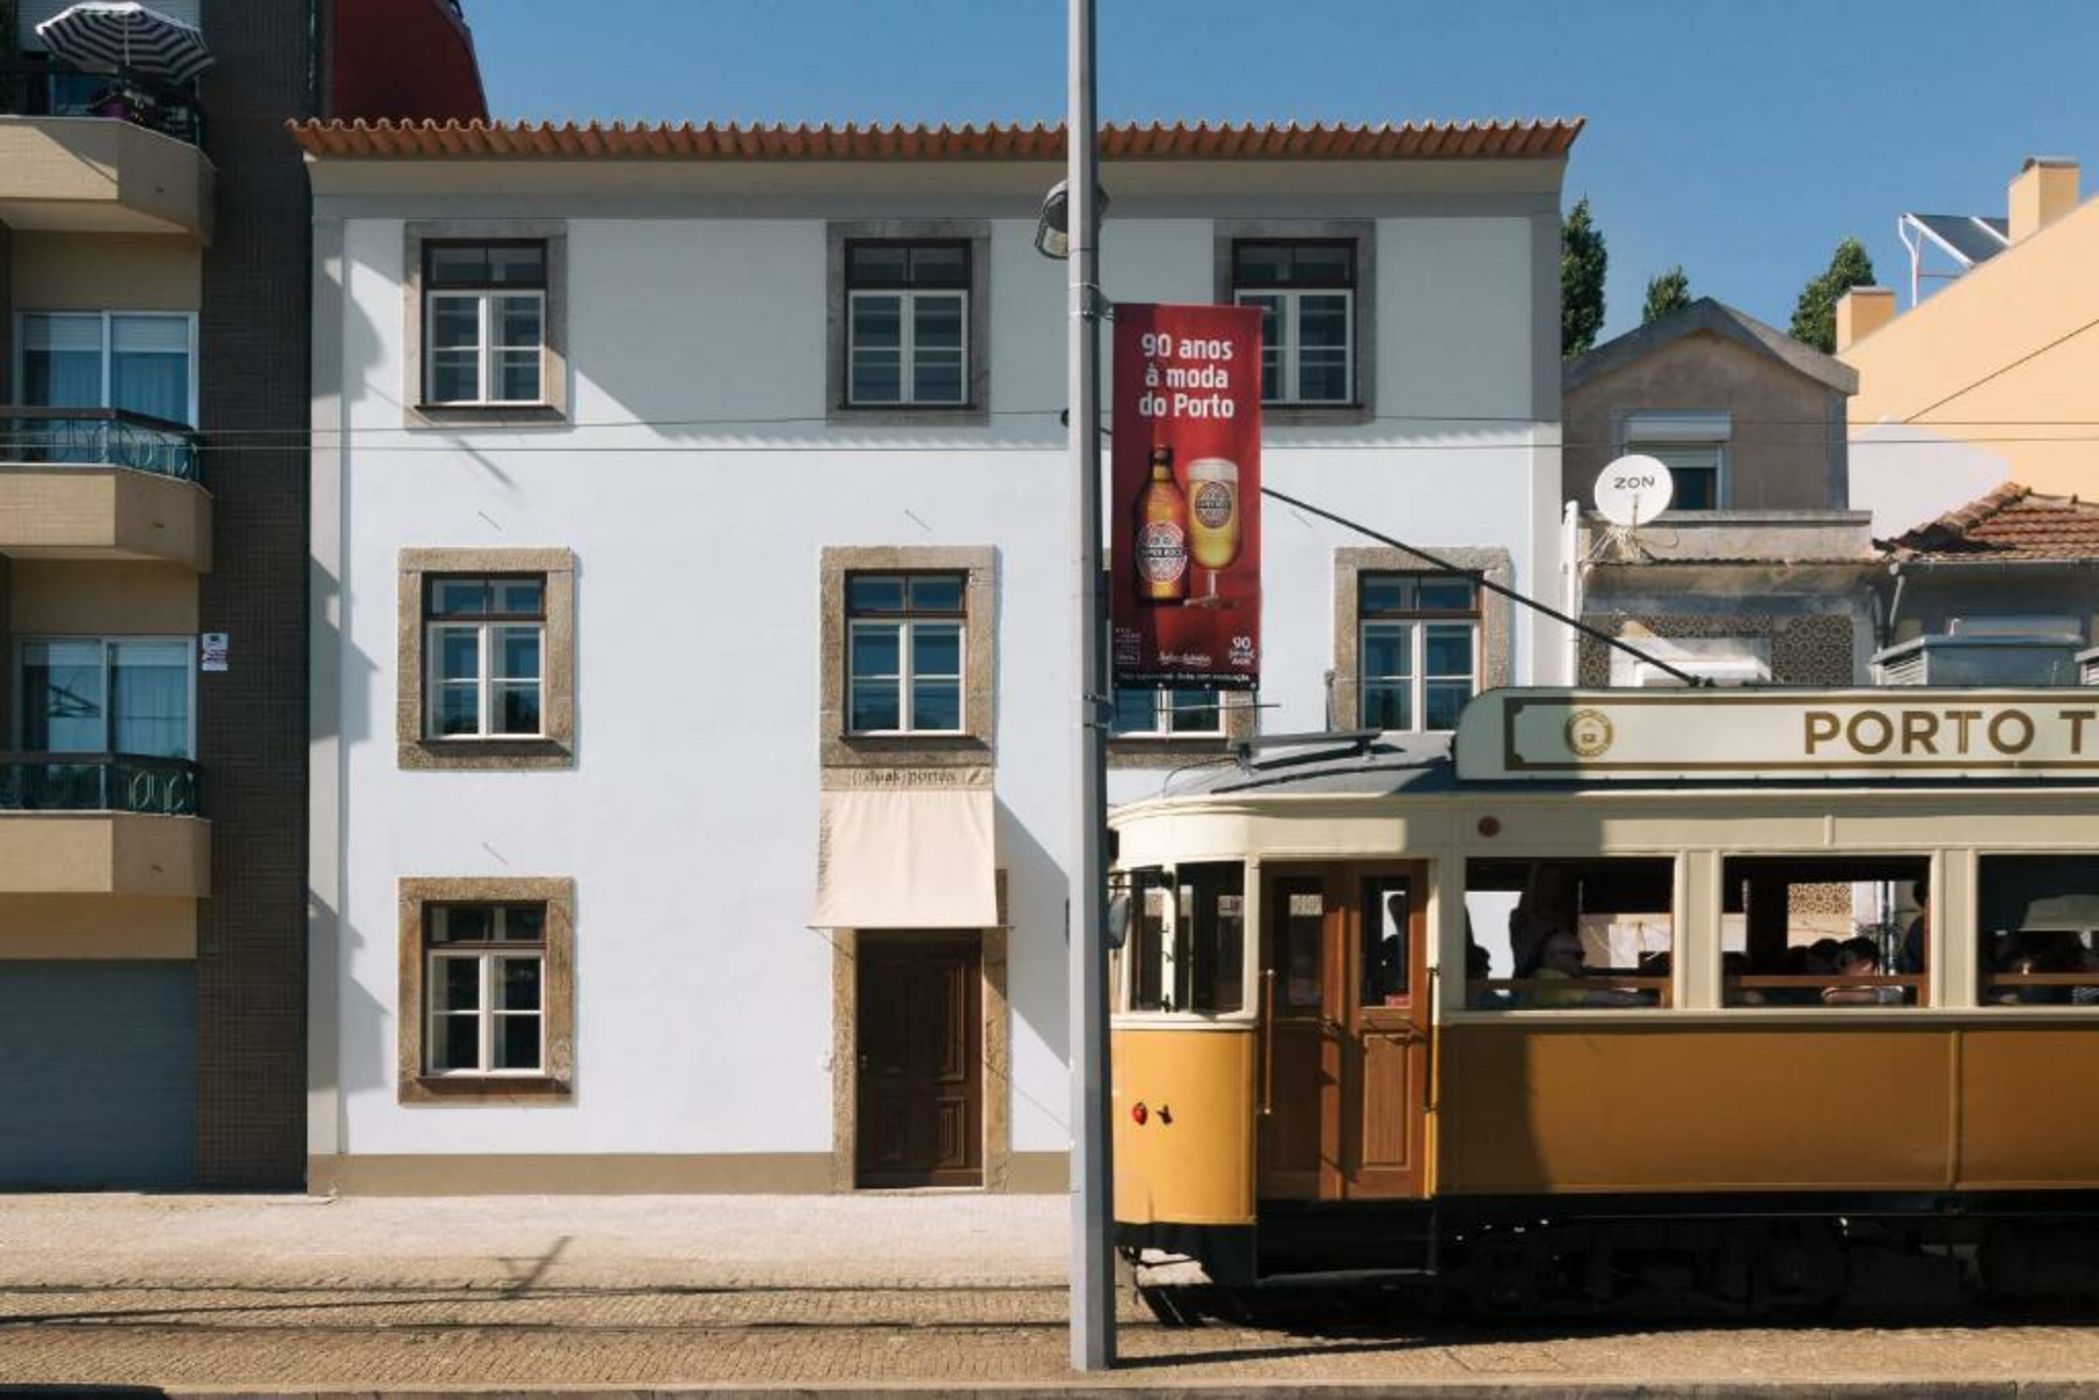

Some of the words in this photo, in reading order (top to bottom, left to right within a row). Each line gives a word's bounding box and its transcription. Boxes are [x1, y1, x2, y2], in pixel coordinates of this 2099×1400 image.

[1142, 333, 1172, 357] 90
[1179, 338, 1233, 360] anos
[1166, 363, 1228, 389] moda
[1140, 391, 1167, 417] do
[1174, 393, 1234, 418] Porto
[1614, 476, 1656, 490] ZON
[1231, 636, 1252, 650] 90
[1804, 709, 2035, 755] PORTO
